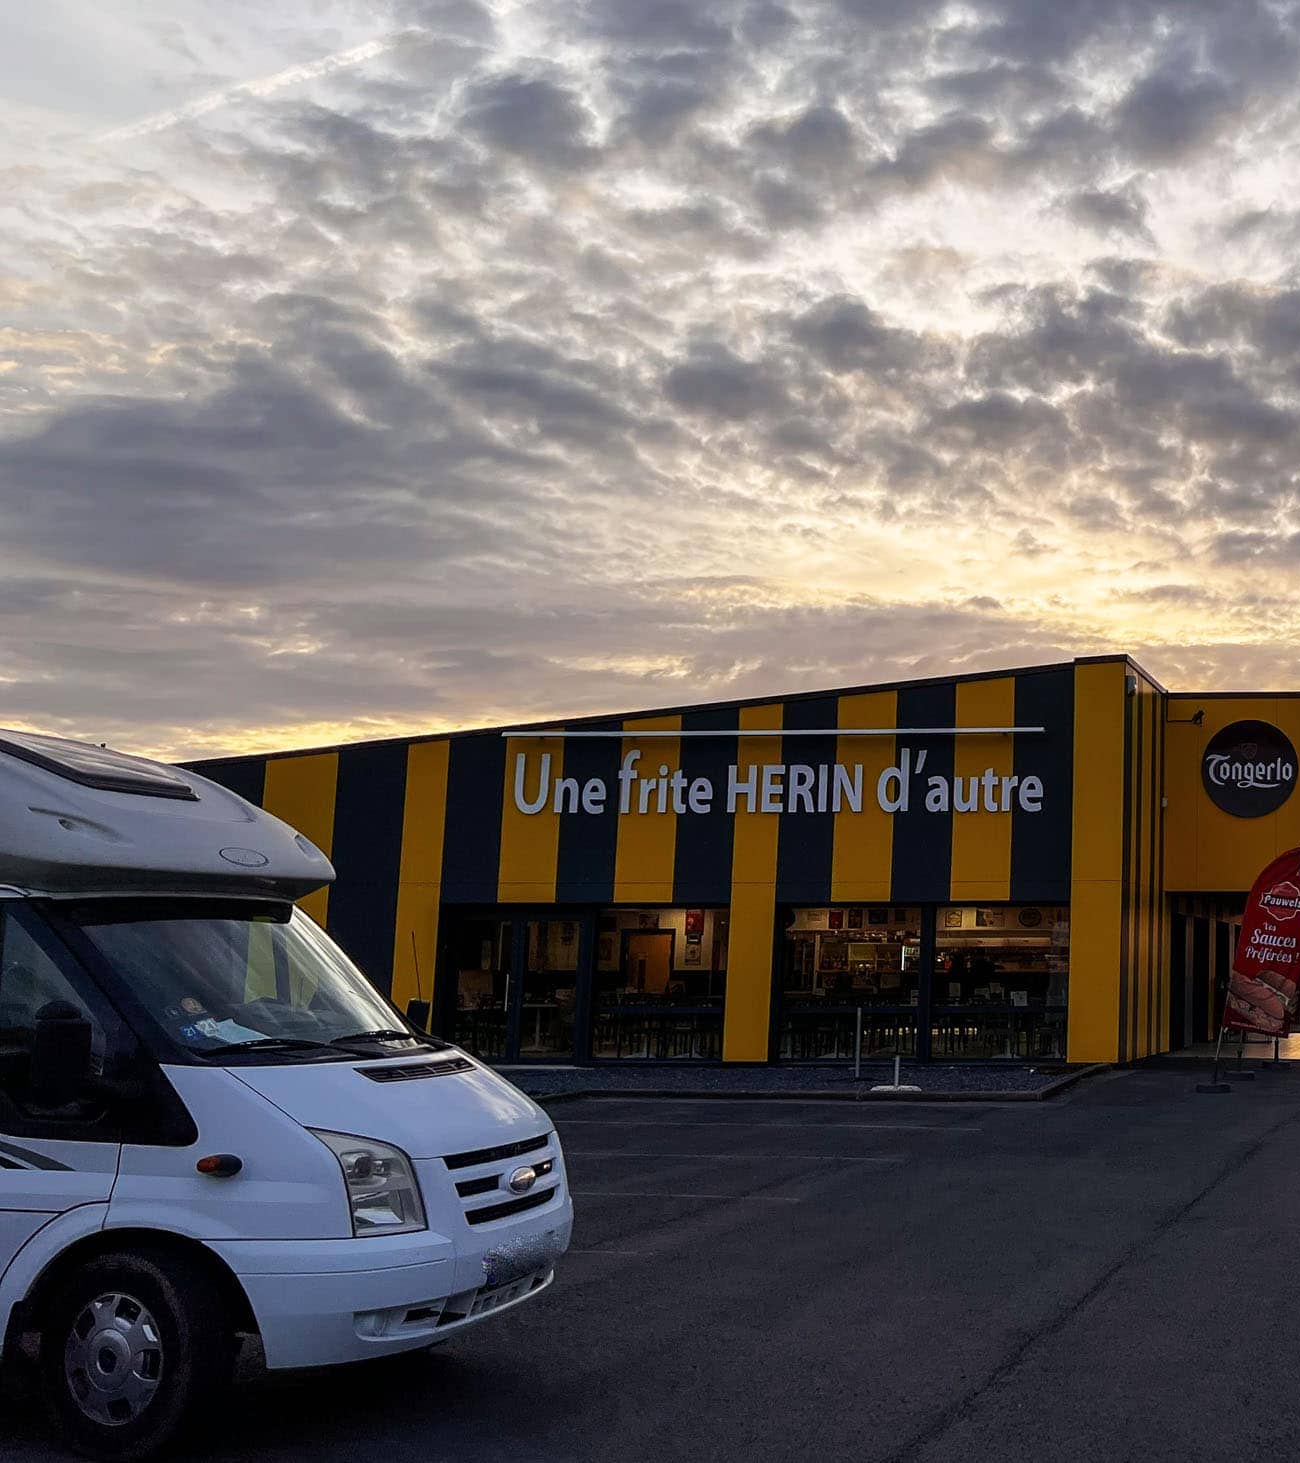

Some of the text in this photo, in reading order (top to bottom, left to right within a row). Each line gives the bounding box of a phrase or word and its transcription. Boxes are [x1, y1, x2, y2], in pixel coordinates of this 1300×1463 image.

[514, 753, 607, 815] Une
[618, 749, 713, 814] frite
[726, 764, 863, 813] HERIN
[1206, 754, 1293, 788] Tongerlo
[1250, 928, 1297, 949] Sauces
[1245, 946, 1293, 964] Préférées
